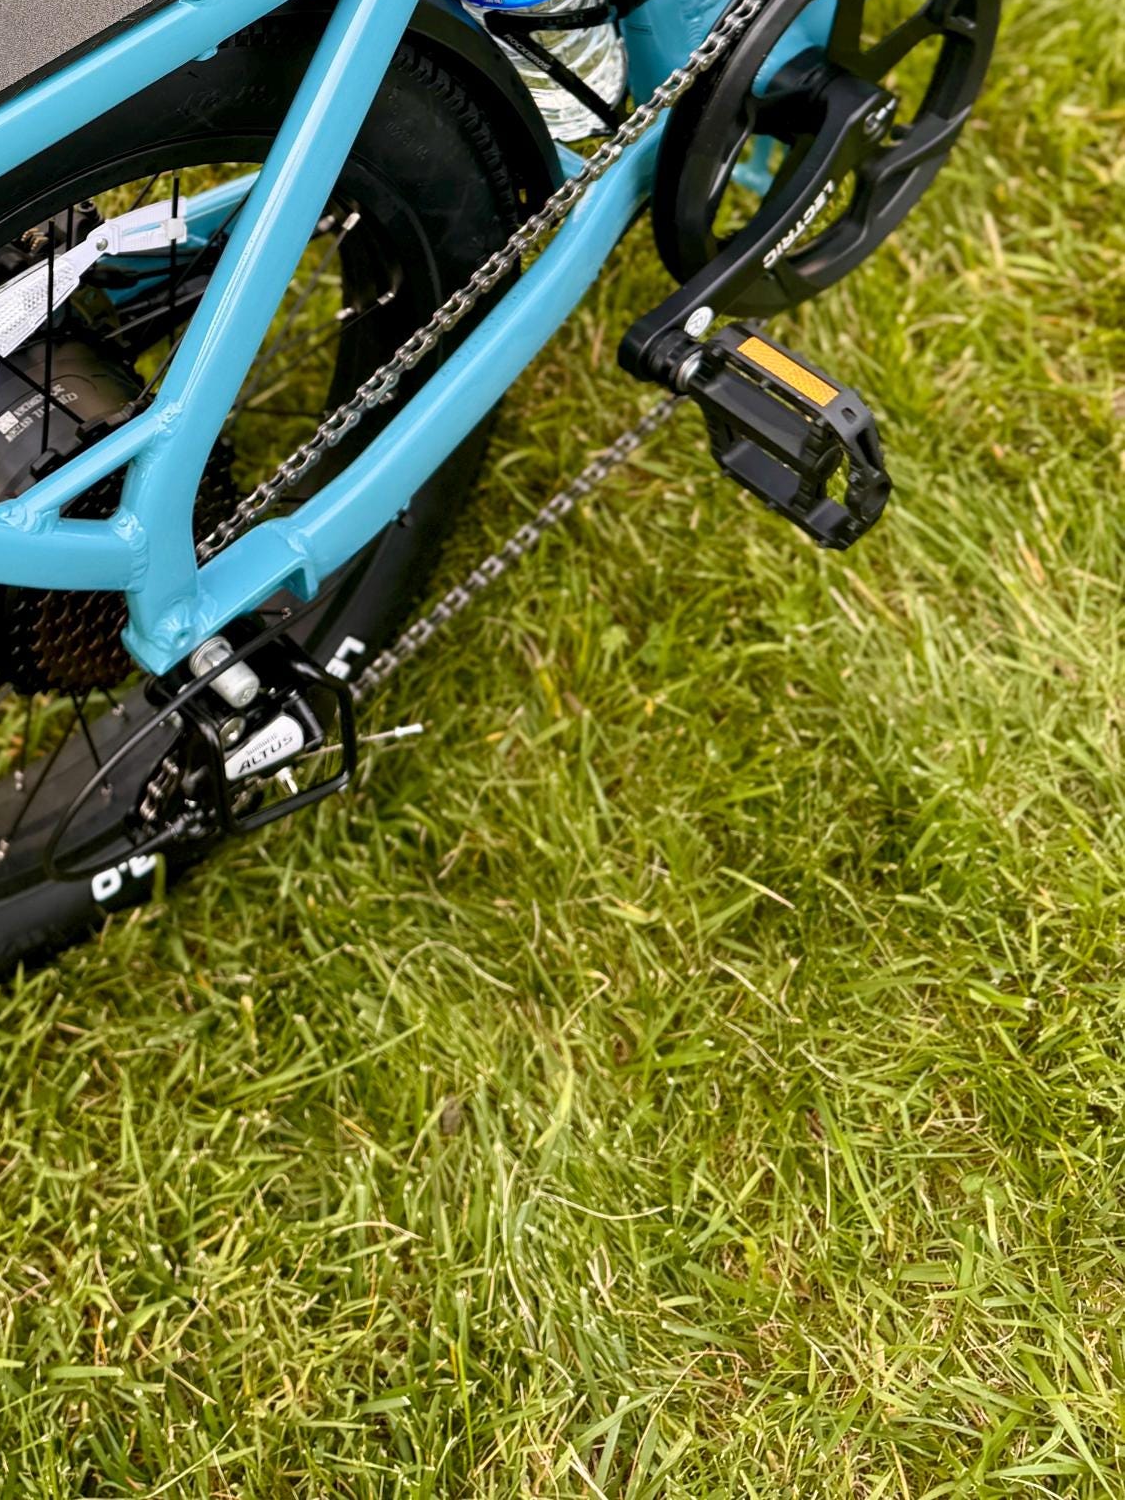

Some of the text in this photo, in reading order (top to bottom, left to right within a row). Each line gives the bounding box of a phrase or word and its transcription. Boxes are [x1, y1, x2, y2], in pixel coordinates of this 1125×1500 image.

[503, 33, 553, 72] ROCKBROS
[762, 179, 834, 270] LECTRIC
[238, 735, 293, 774] ALTUS
